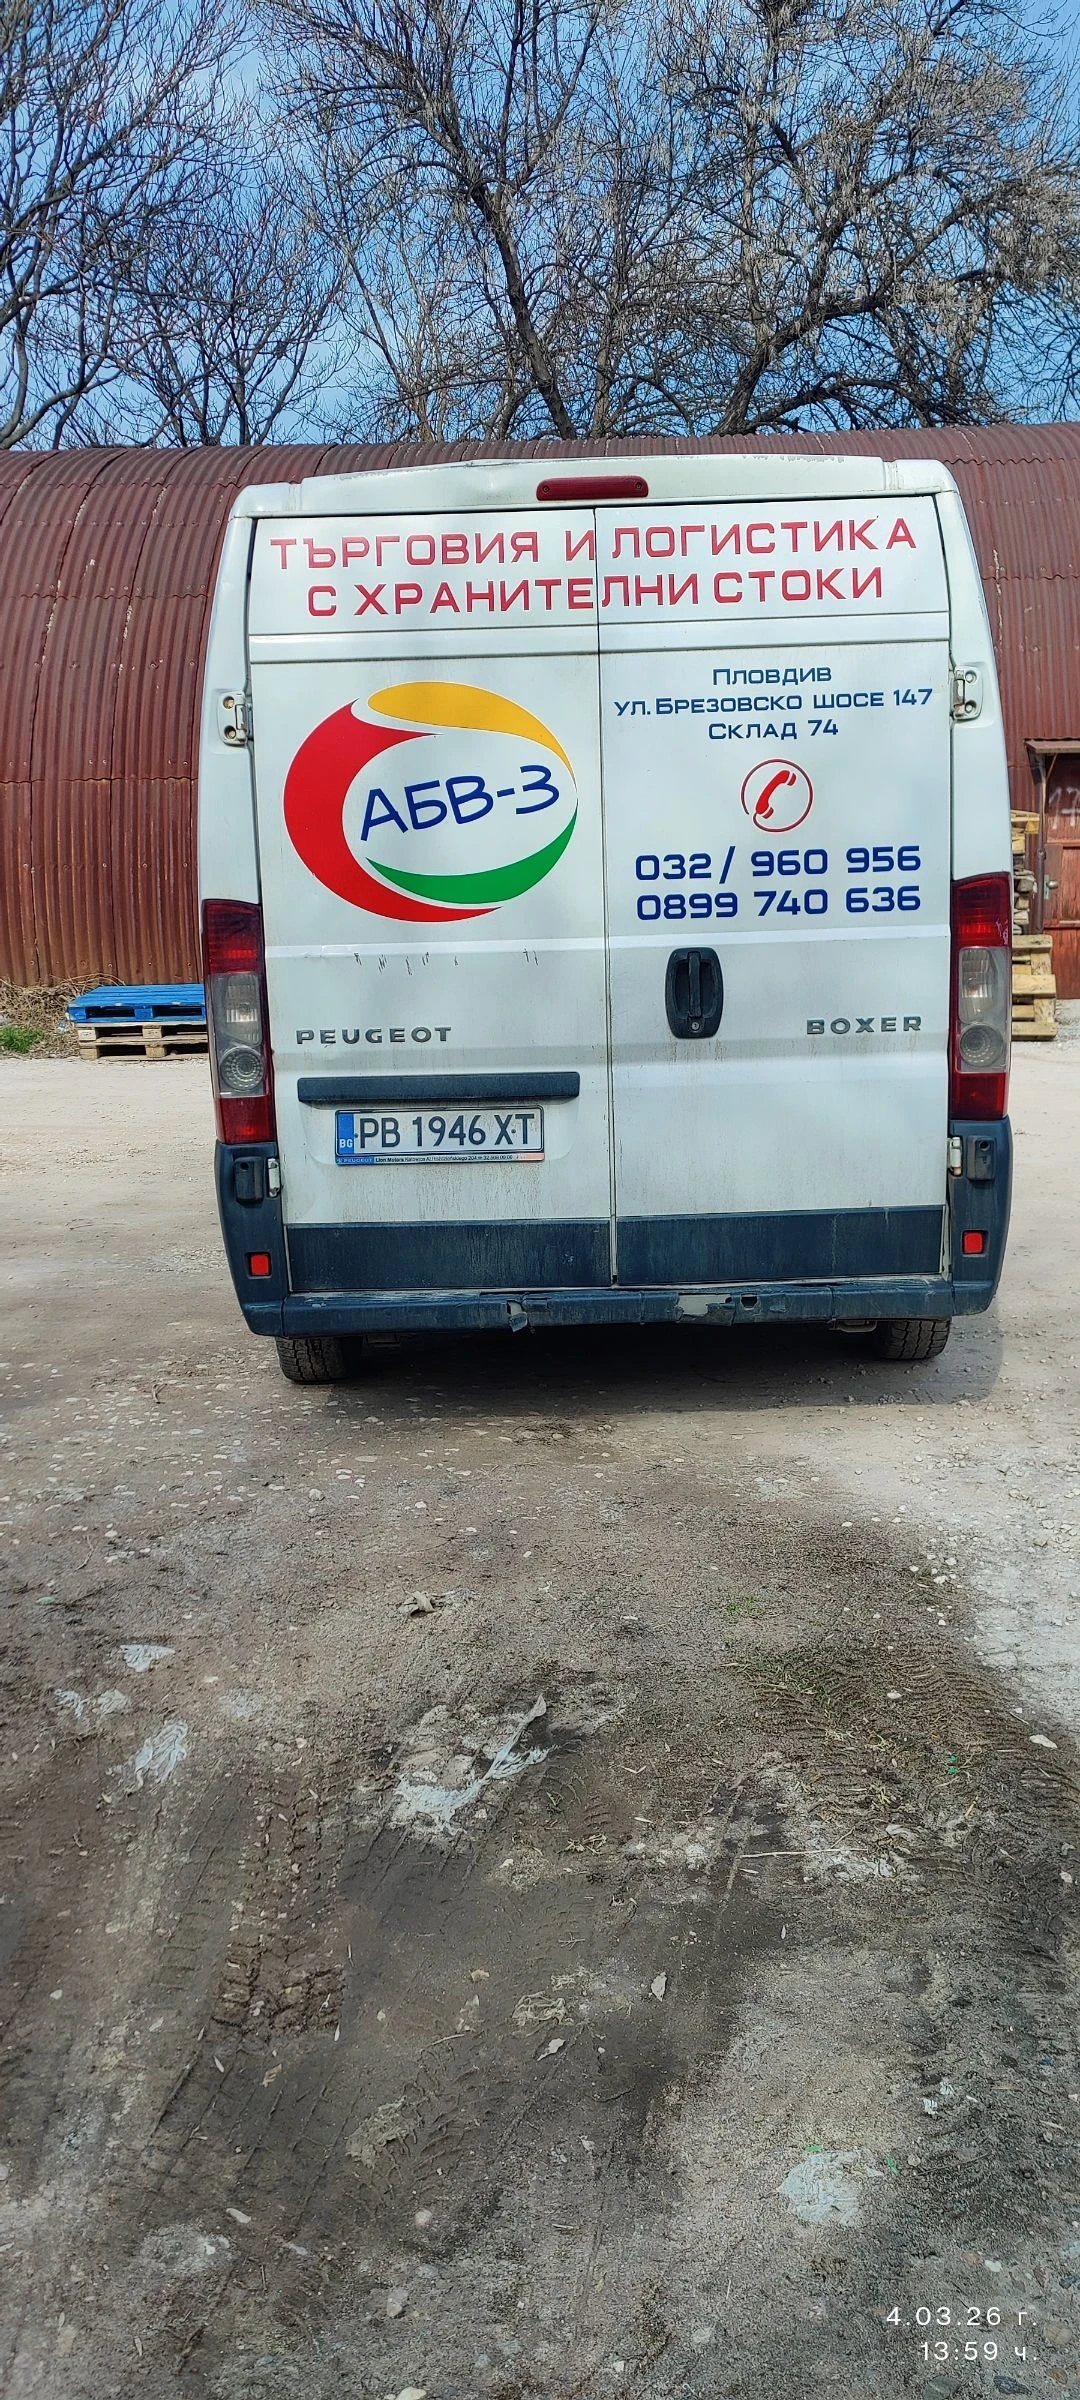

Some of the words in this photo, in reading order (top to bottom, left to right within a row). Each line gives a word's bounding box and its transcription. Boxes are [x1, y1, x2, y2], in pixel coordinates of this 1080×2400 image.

[270, 531, 539, 569] ТЪРГОВИЯ
[565, 529, 596, 562] И
[612, 518, 917, 558] ЛОГИСТИКА
[308, 585, 337, 617] С
[354, 574, 699, 616] ХРАНИТЕЛНИ
[713, 567, 883, 604] СТОКИ
[892, 686, 934, 706] 147
[807, 717, 841, 737] 74
[750, 847, 830, 879] 960
[844, 843, 924, 875] 956
[635, 890, 740, 922] 0899
[753, 887, 830, 918] 740
[843, 884, 924, 915] 636
[296, 1026, 452, 1045] PEUGEOT
[806, 1016, 922, 1035] BOXER
[339, 1137, 353, 1149] BG
[359, 1117, 401, 1149] PB
[411, 1114, 487, 1147] 1946
[493, 1113, 535, 1146] XT
